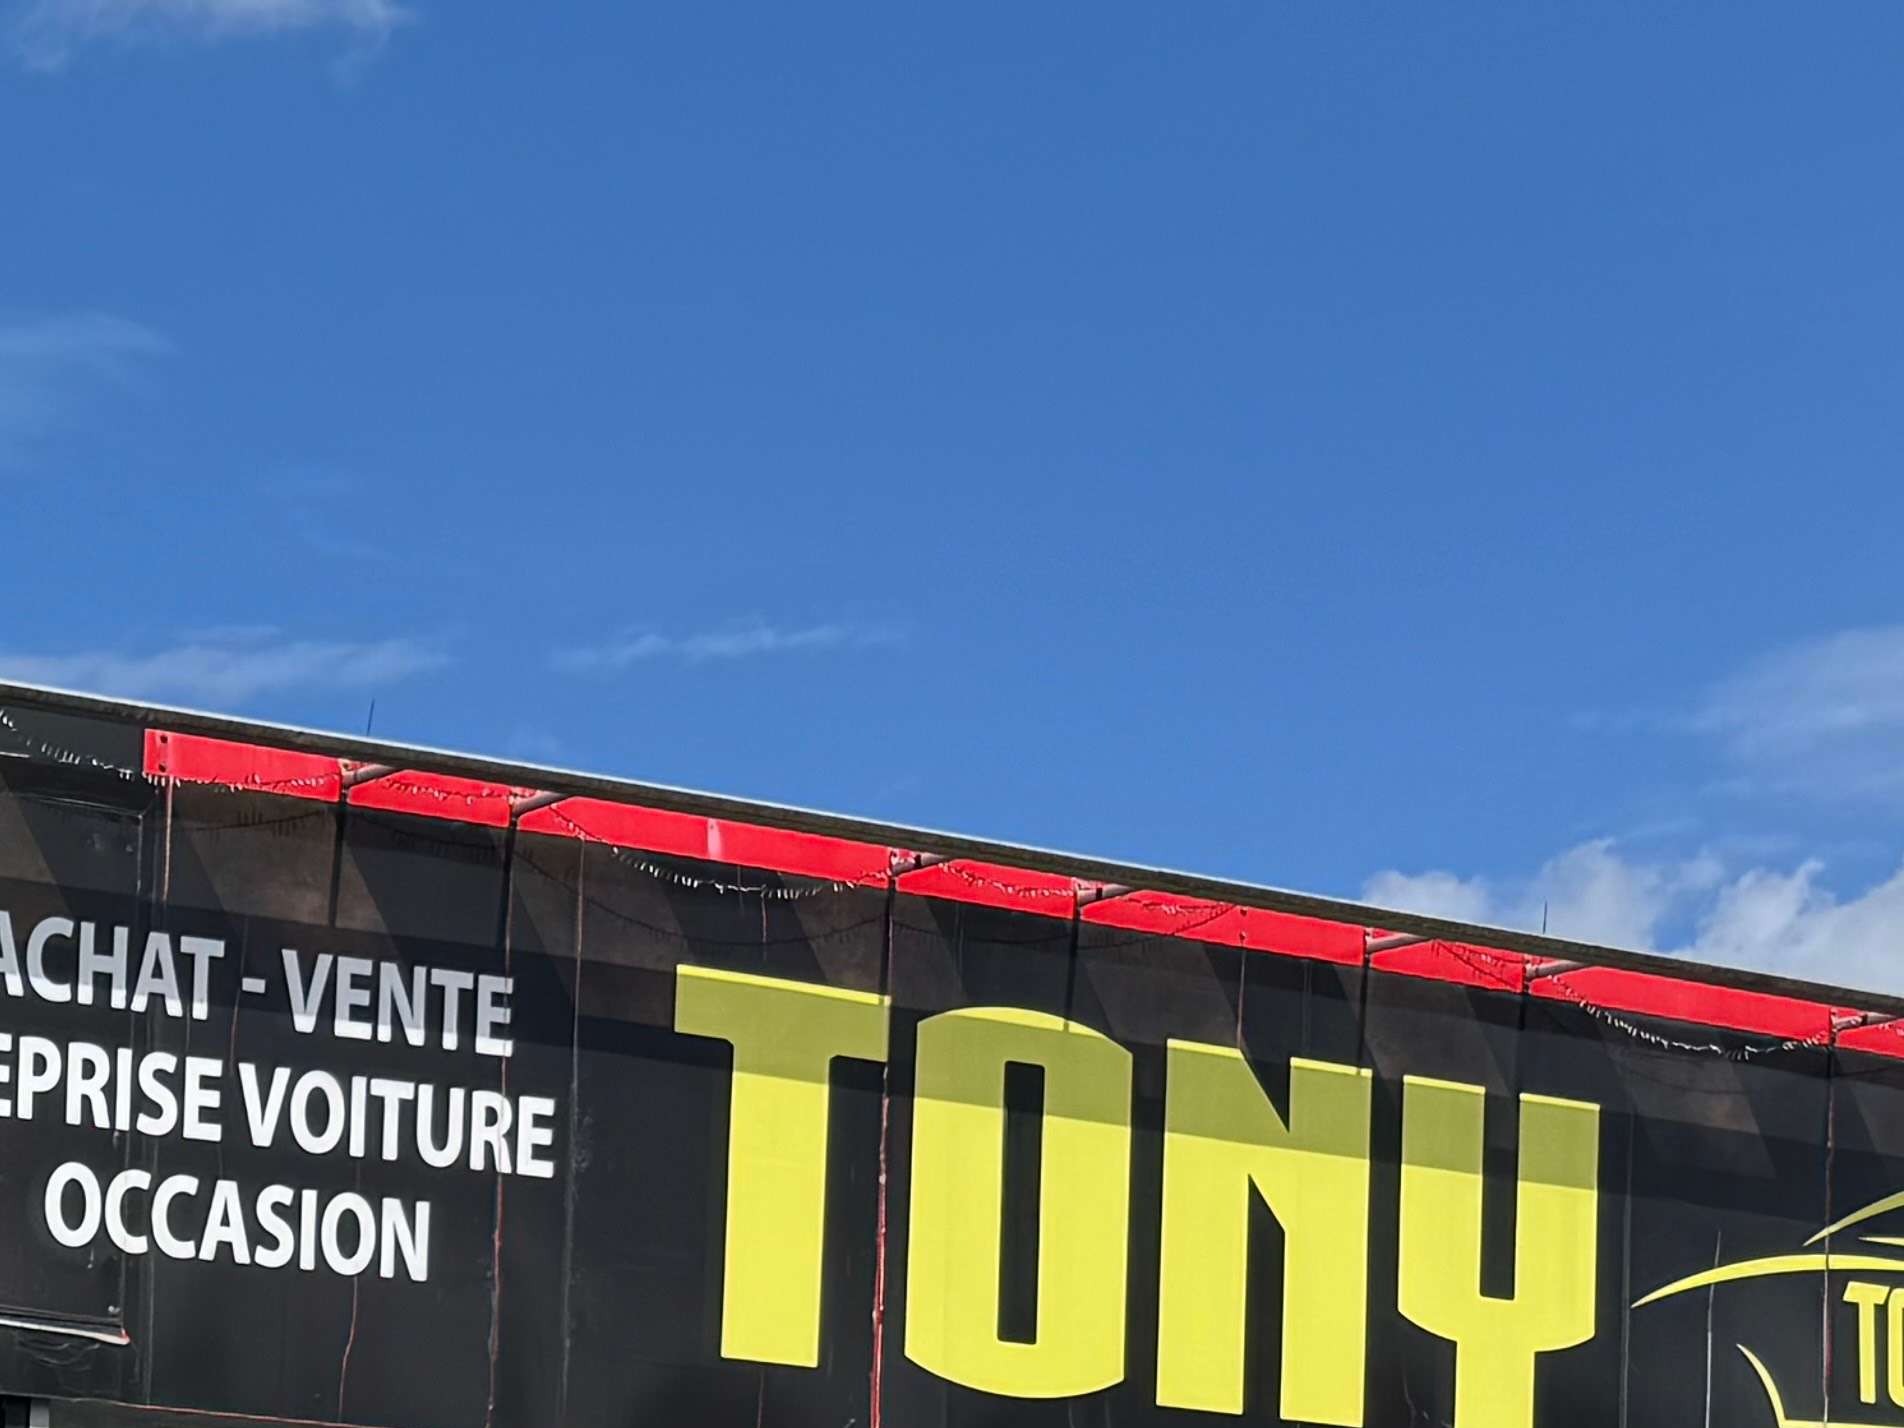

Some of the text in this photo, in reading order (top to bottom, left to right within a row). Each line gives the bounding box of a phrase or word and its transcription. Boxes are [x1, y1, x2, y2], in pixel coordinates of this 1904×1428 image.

[282, 948, 515, 1058] VENTE
[238, 1062, 556, 1179] VOITURE
[44, 1161, 431, 1284] OCCASION
